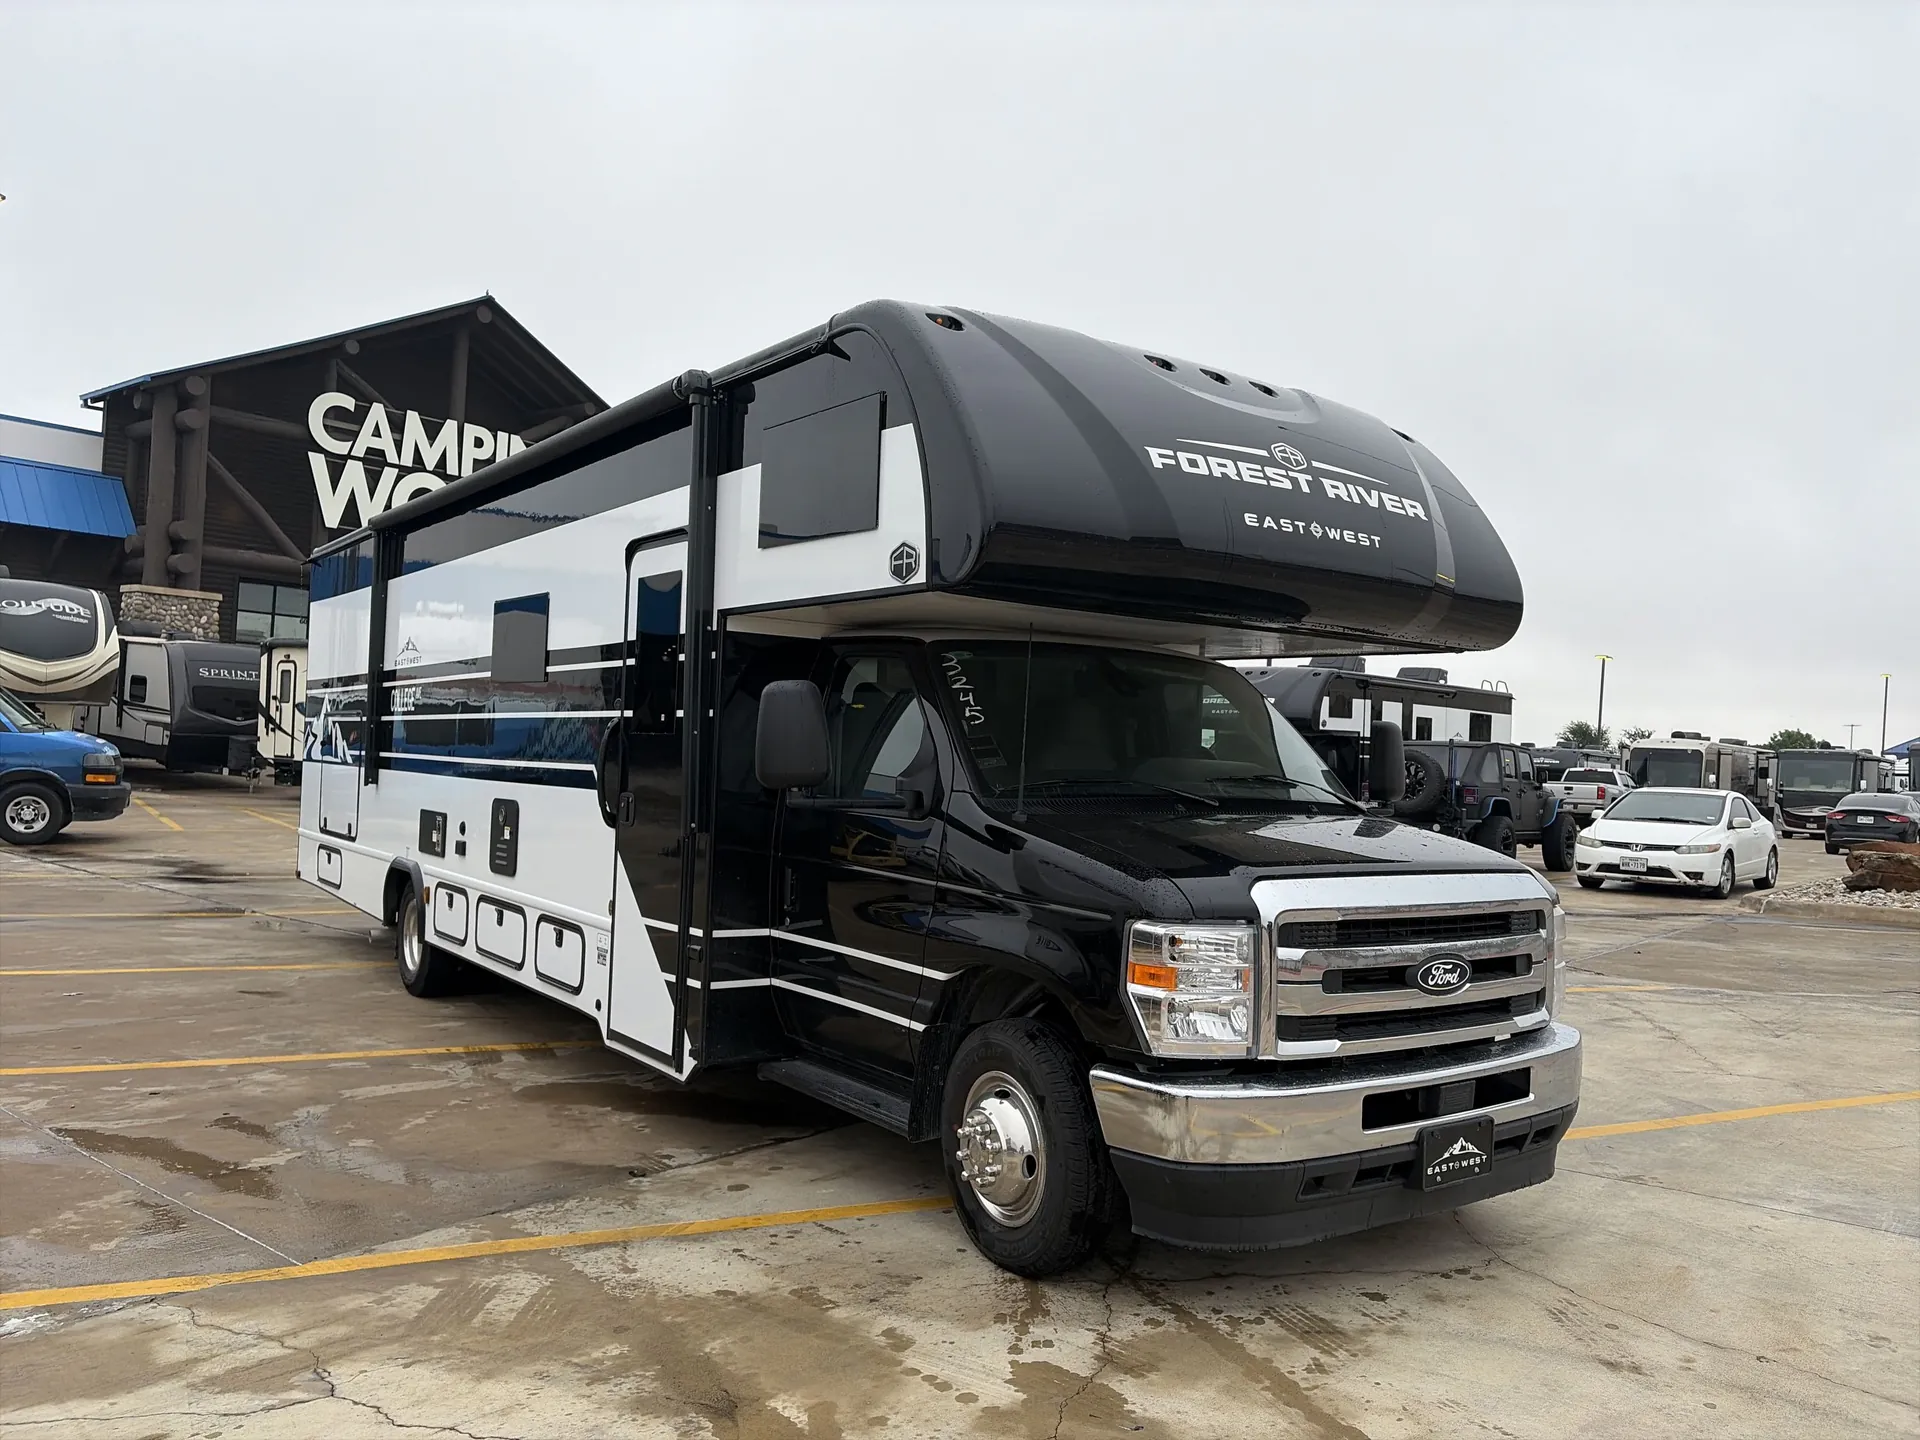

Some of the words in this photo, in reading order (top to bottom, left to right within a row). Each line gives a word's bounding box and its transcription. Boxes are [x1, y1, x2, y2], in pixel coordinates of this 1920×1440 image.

[1144, 446, 1312, 493] FOREST
[1319, 477, 1429, 521] RIVER
[1244, 513, 1306, 534] EAST
[1325, 526, 1381, 549] WEST
[0, 600, 92, 618] OLITUDE
[391, 688, 416, 712] COLLEGE
[1428, 964, 1461, 986] Ford
[1427, 1162, 1454, 1175] EAST
[1461, 1155, 1487, 1167] WEST
